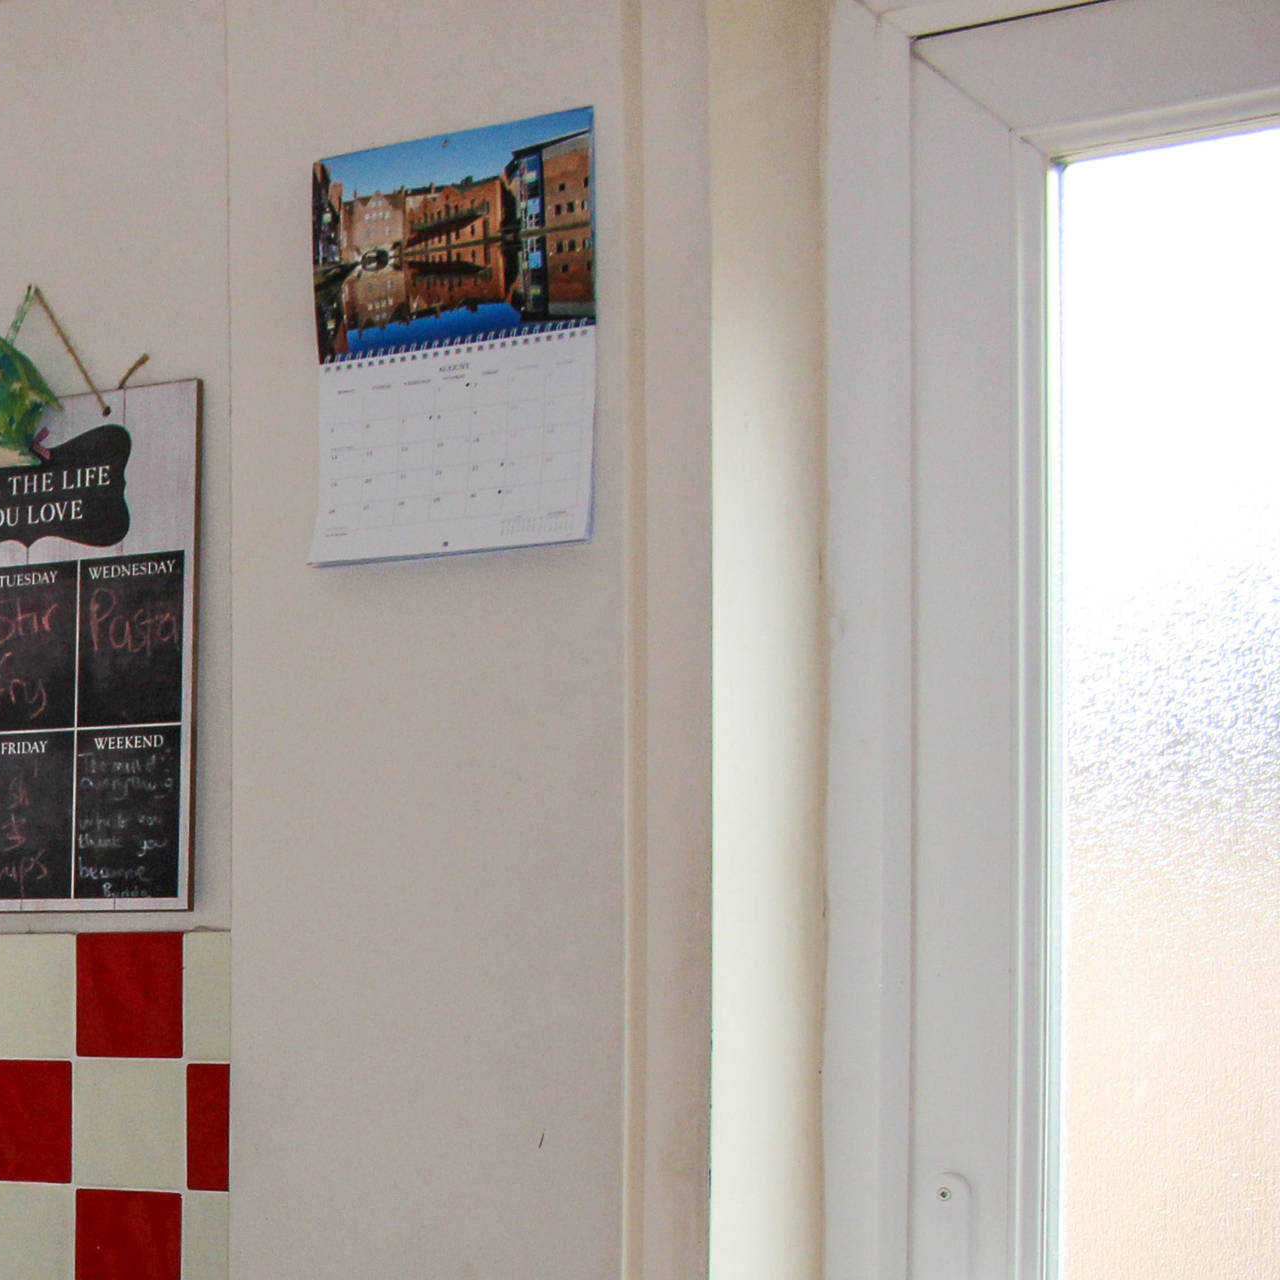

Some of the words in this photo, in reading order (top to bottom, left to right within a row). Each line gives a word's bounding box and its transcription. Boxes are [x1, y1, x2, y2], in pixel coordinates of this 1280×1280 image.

[8, 472, 54, 496] THE
[62, 465, 111, 490] LIFE
[27, 500, 83, 525] LOVE
[88, 559, 176, 580] WEDNESDAY
[0, 740, 48, 755] FRIDAY
[94, 734, 164, 750] WEEKEND
